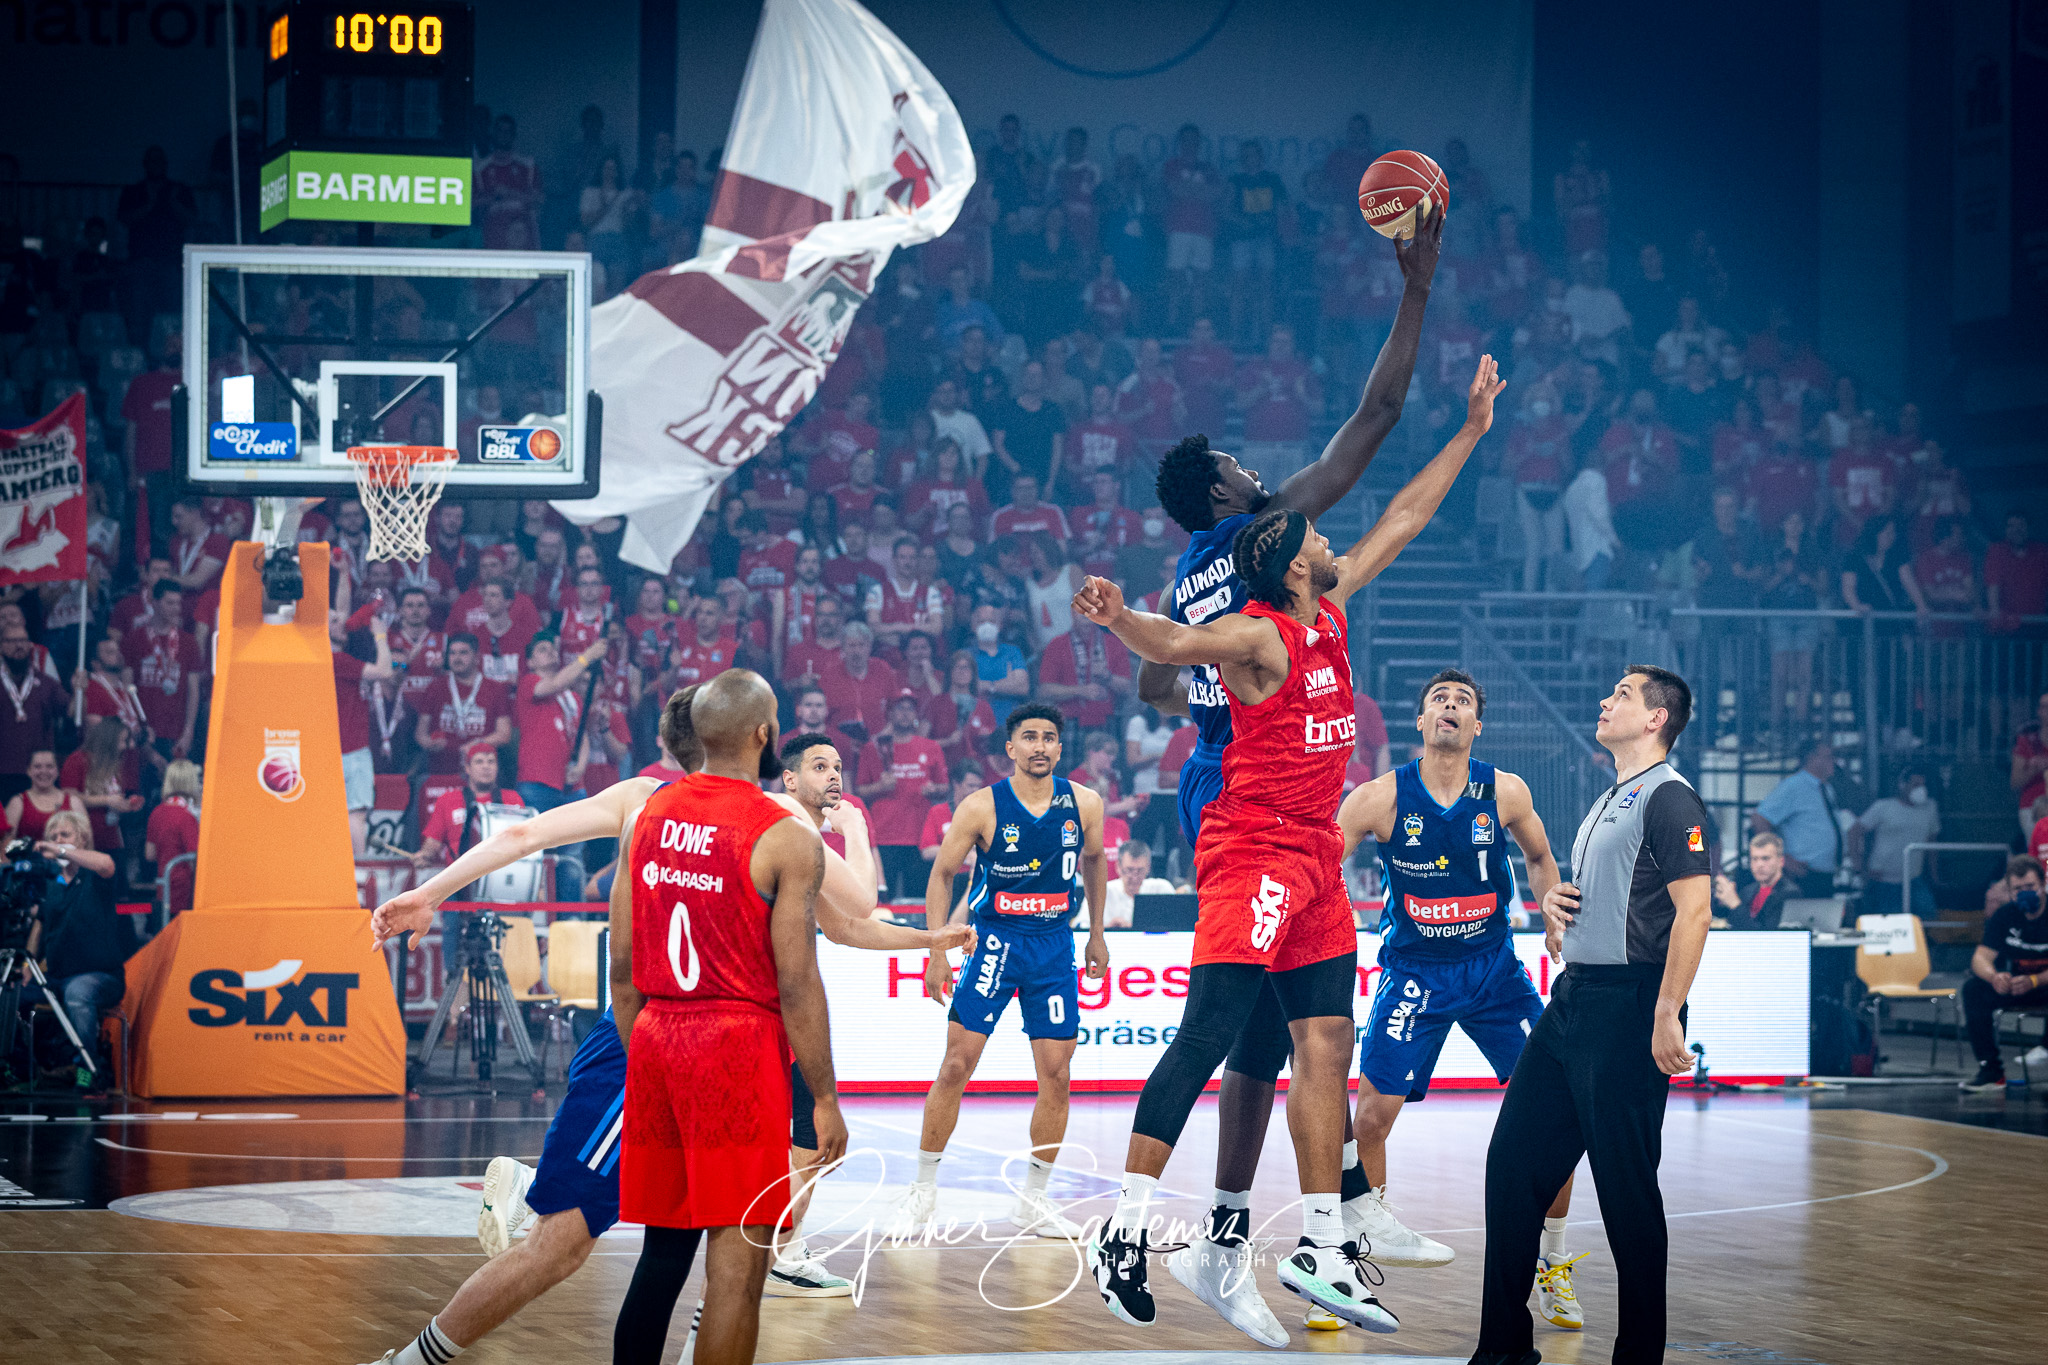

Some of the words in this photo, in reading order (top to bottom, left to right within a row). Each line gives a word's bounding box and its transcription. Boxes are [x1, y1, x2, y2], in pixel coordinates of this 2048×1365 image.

[297, 171, 464, 206] BARMER
[235, 439, 288, 455] Credit
[484, 443, 520, 459] BBL
[660, 819, 718, 856] DOWE
[1062, 851, 1077, 880] 0
[1392, 856, 1435, 870] interseroh
[1477, 850, 1488, 881] 1
[660, 866, 724, 893] IGARASHI
[1000, 895, 1068, 911] bett1.com
[1409, 899, 1491, 920] bett1.com
[667, 901, 700, 991] 0
[975, 954, 998, 997] ALBA
[1048, 995, 1065, 1024] 0
[1386, 1000, 1418, 1041] ALBA
[254, 1031, 294, 1041] rent
[300, 1032, 310, 1041] a
[316, 1032, 346, 1042] car
